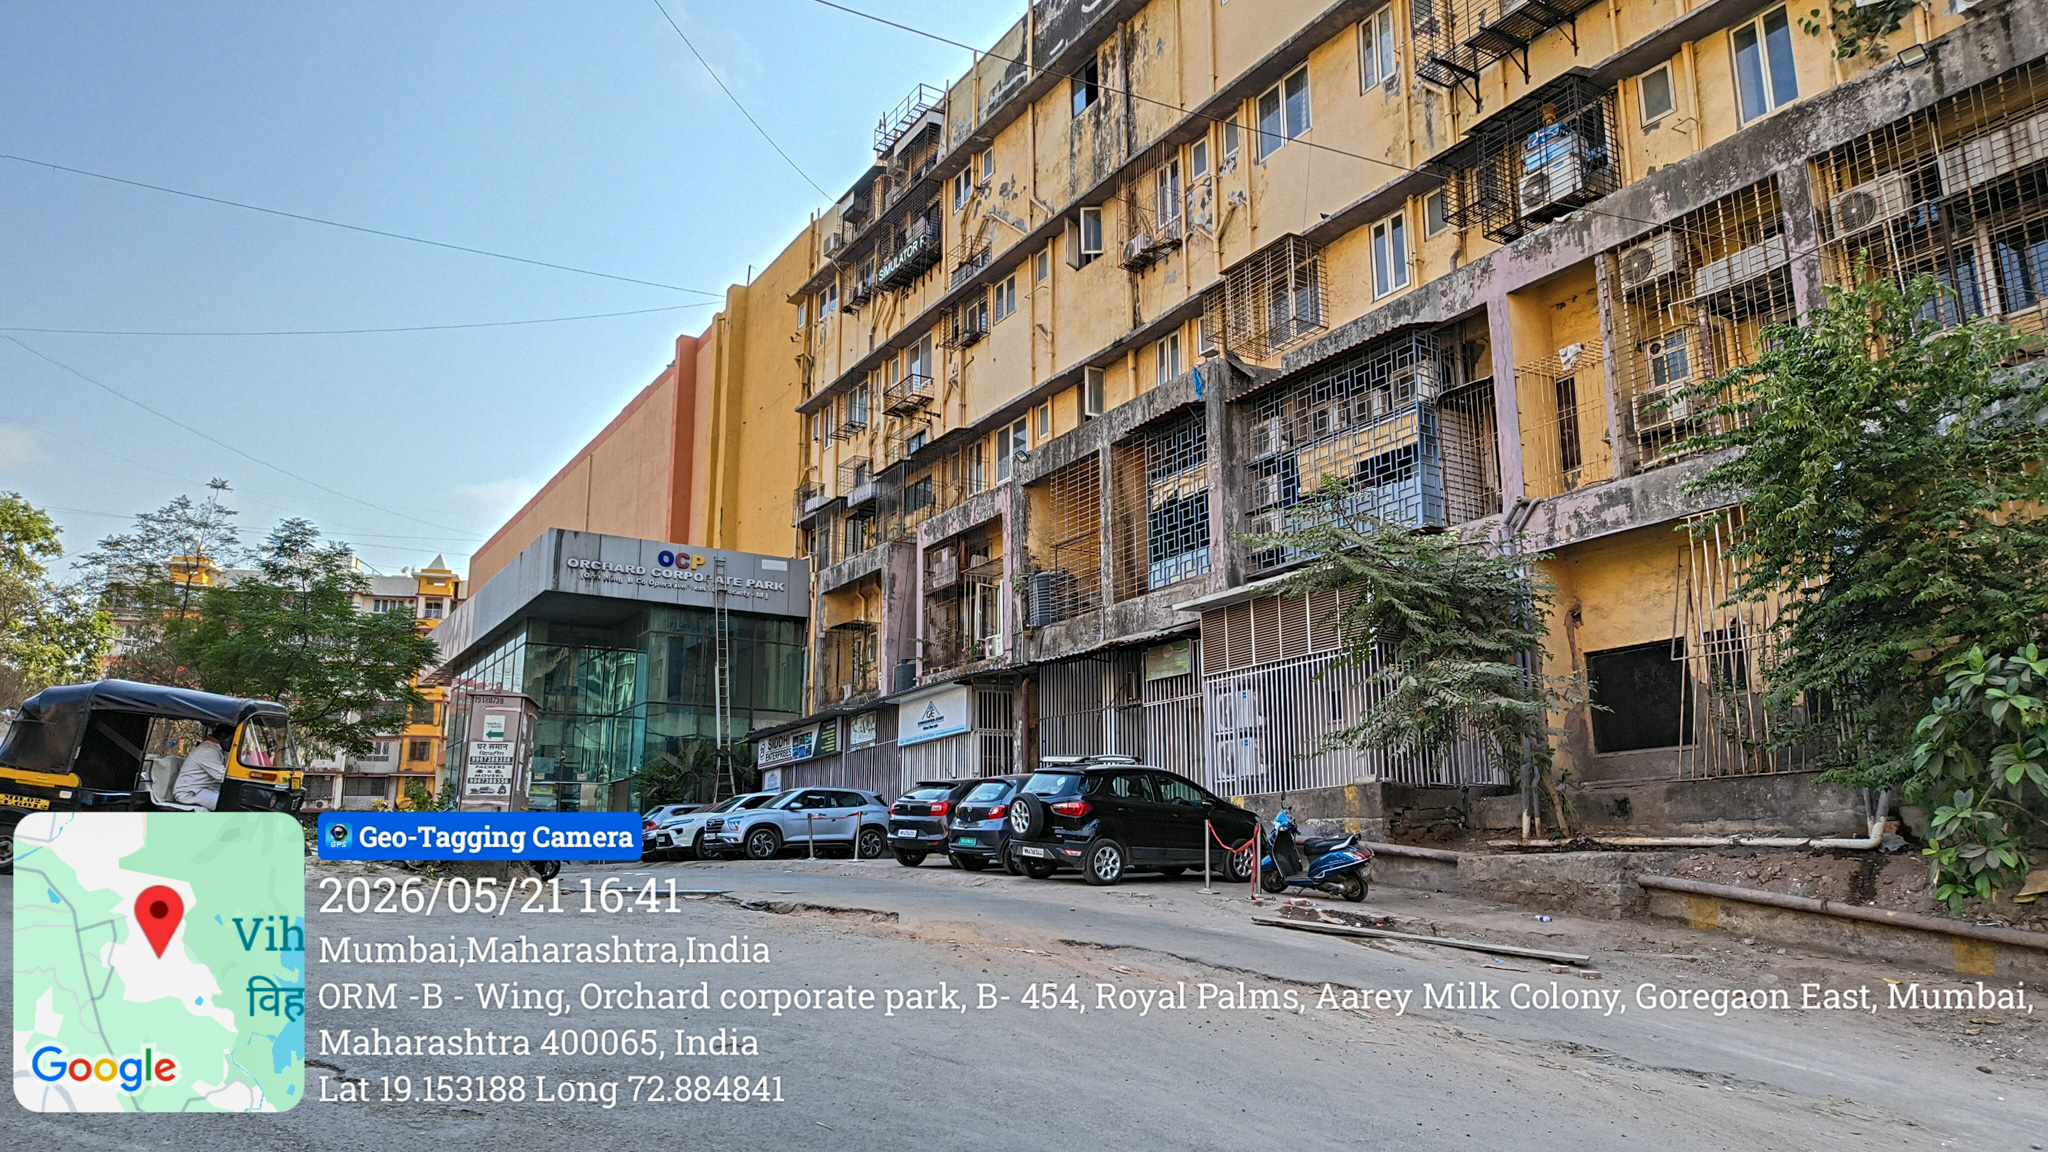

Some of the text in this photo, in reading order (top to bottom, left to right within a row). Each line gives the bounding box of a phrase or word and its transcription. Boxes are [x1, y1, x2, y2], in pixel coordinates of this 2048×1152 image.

[878, 240, 918, 281] SIMULATOR
[657, 550, 706, 570] OCP
[567, 558, 646, 576] ORCHARD
[745, 578, 785, 591] PARK
[765, 747, 791, 761] ENTERPRISES
